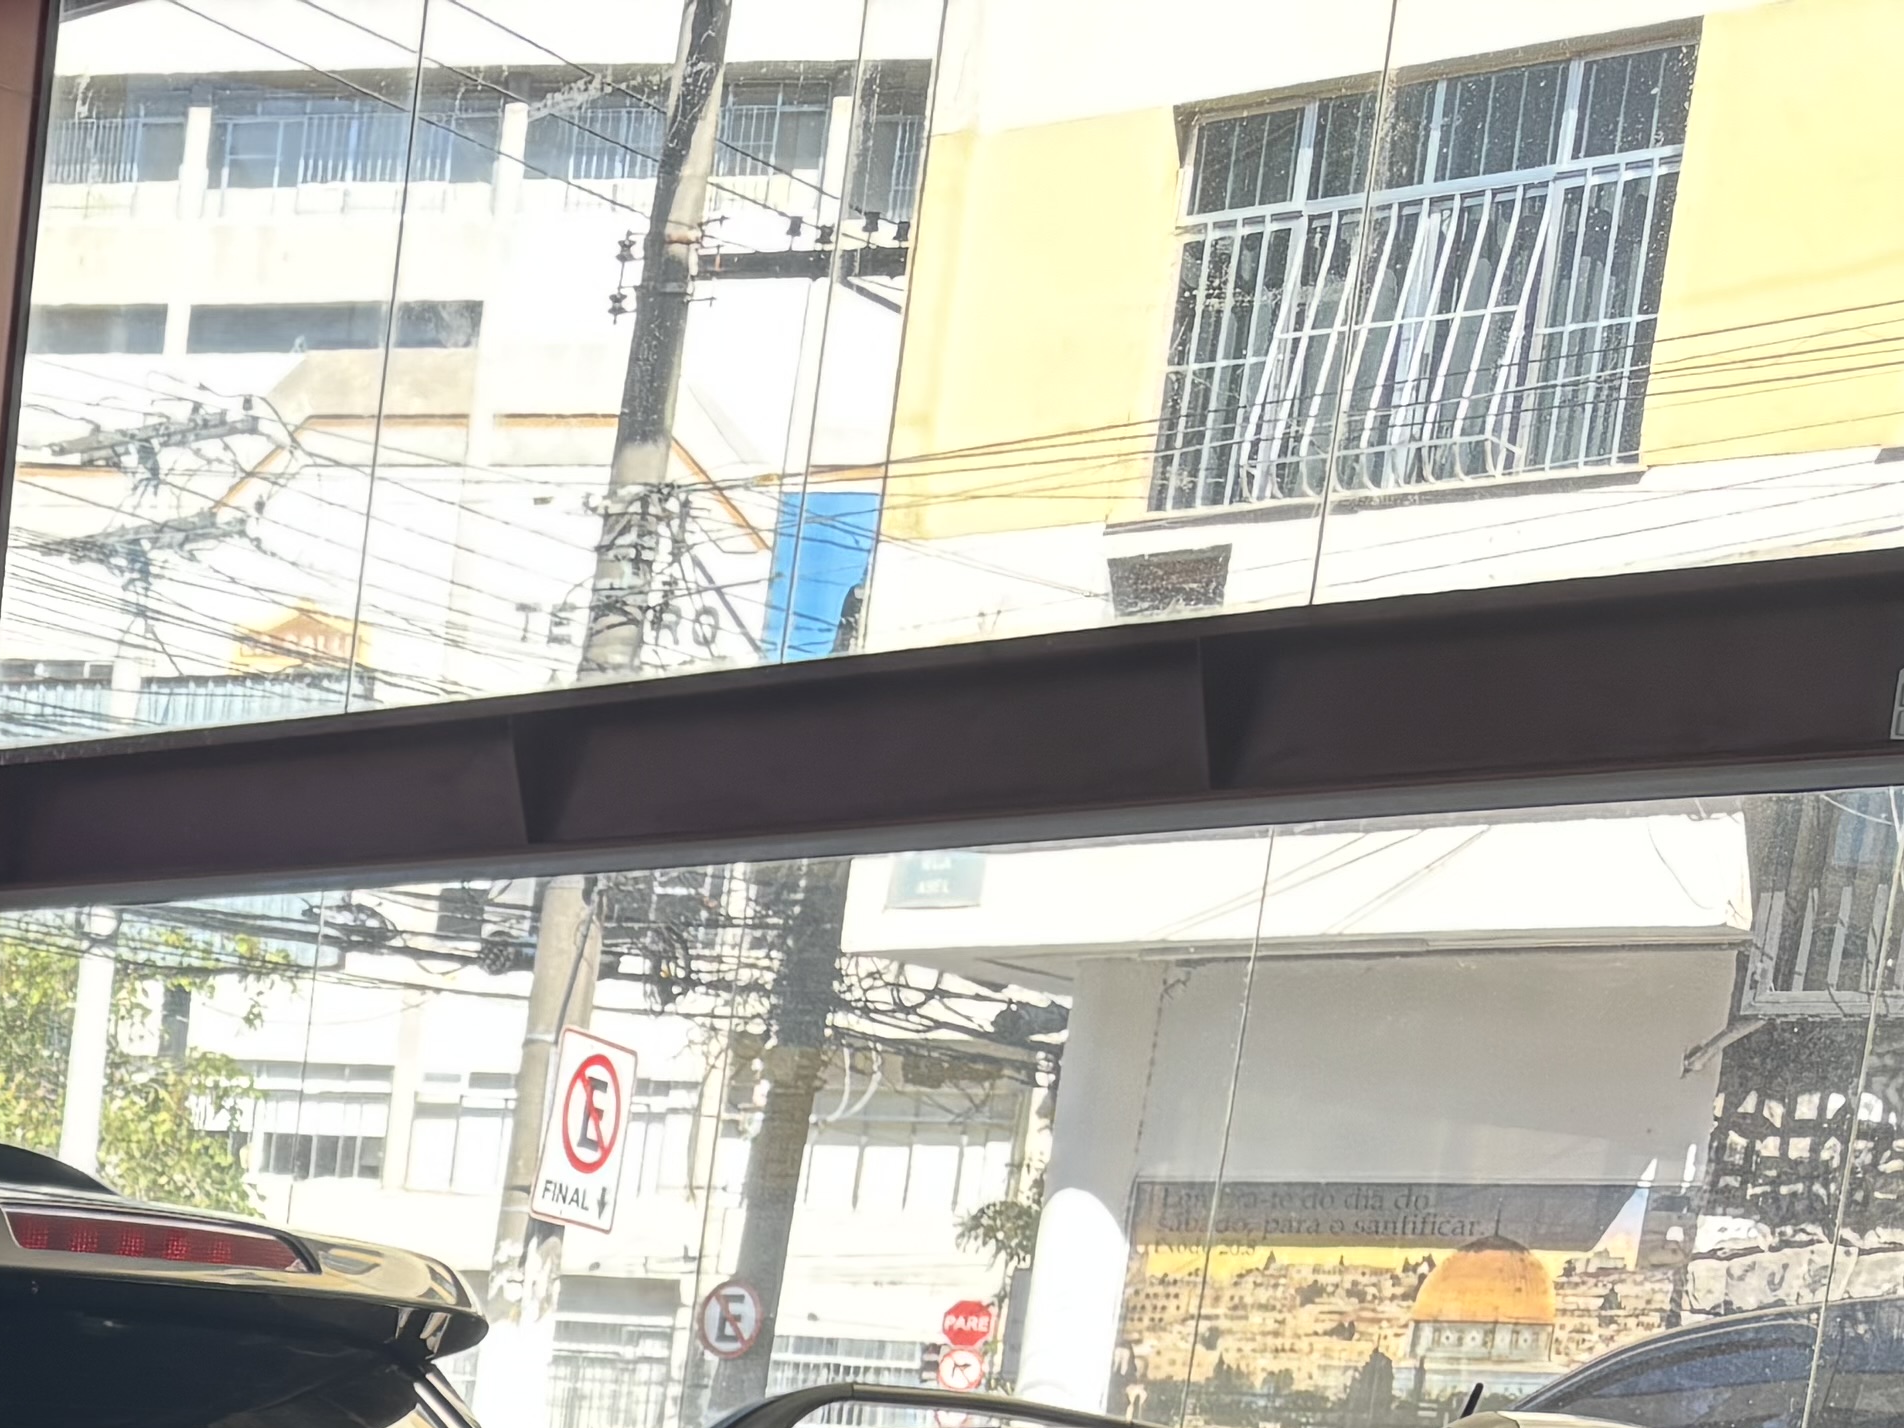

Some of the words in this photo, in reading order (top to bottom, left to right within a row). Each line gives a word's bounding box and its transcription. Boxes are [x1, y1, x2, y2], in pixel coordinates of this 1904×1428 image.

[515, 600, 720, 647] TERO
[542, 1179, 590, 1212] FINAL
[1344, 1186, 1384, 1210] dia
[1393, 1186, 1430, 1210] do
[1260, 1217, 1321, 1240] para
[1329, 1218, 1345, 1235] o
[944, 1314, 990, 1334] PARE
